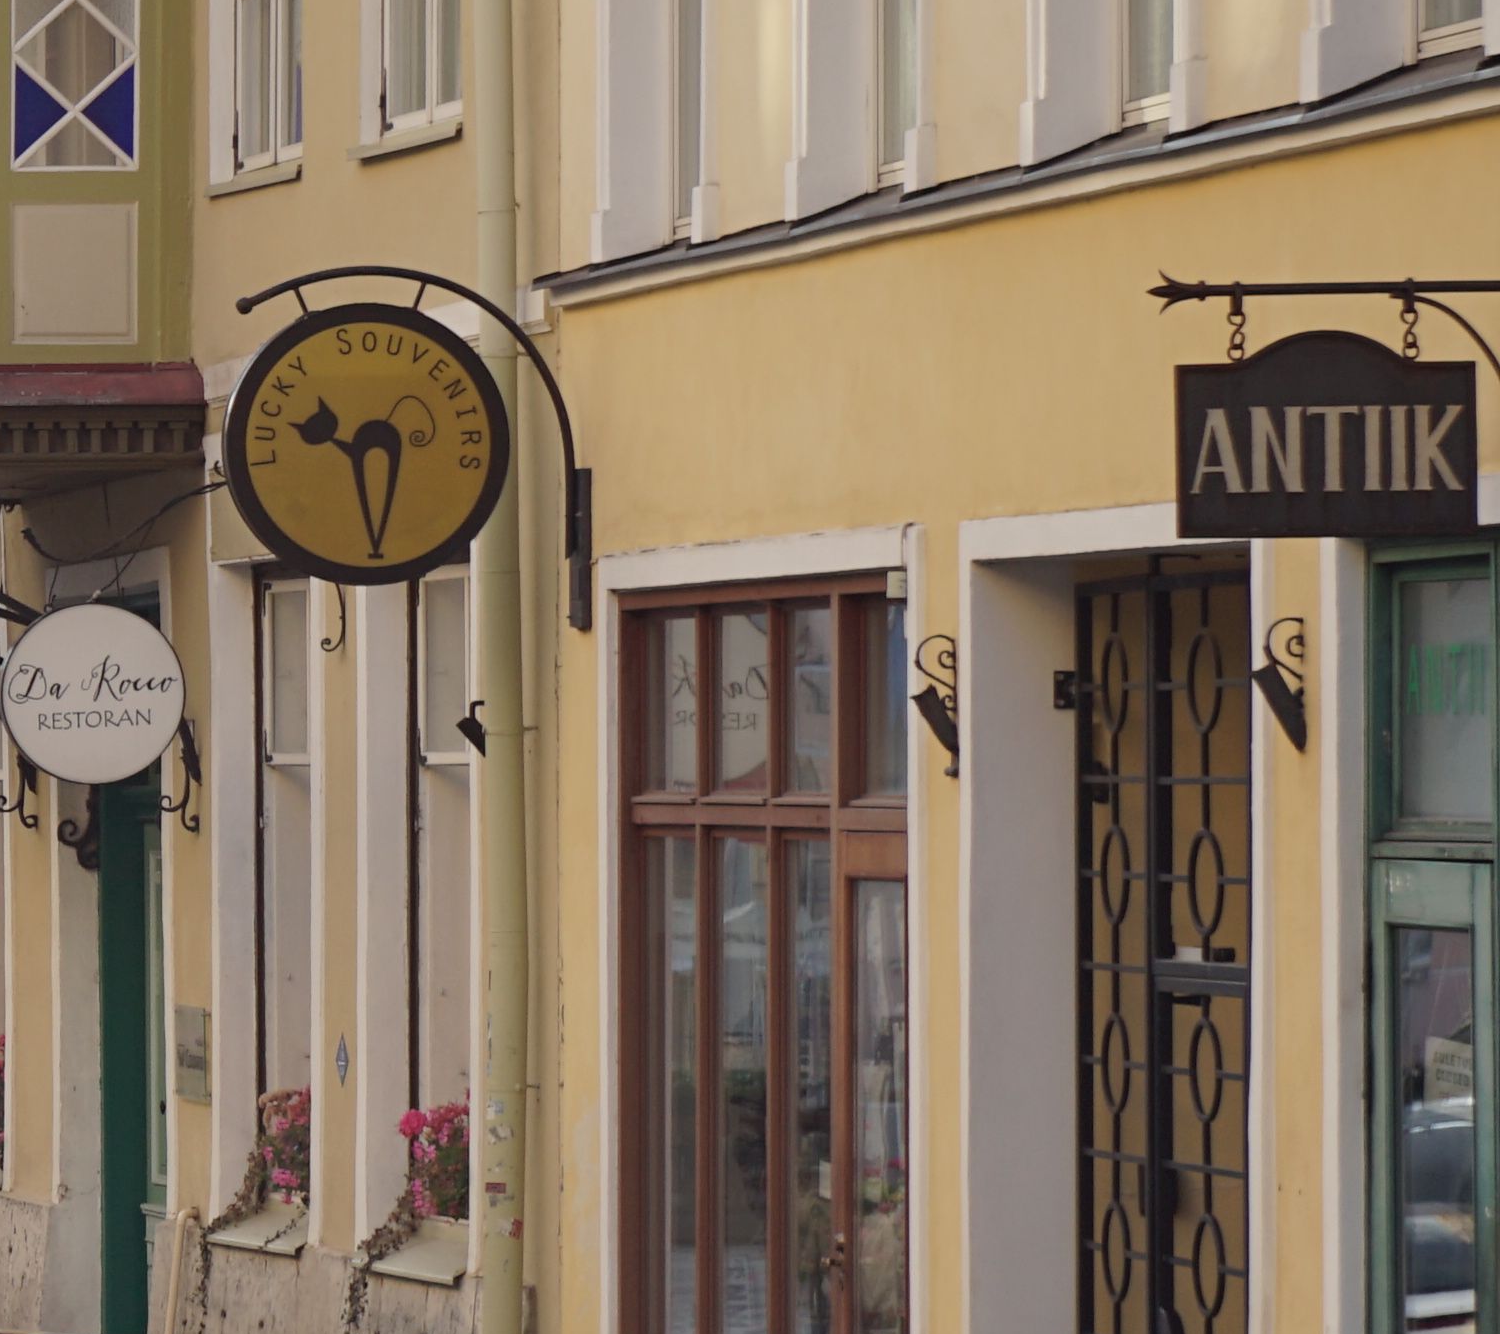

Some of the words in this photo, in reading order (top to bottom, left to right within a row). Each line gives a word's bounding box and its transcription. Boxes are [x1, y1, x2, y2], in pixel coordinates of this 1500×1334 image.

[249, 355, 310, 467] LUCKY
[335, 327, 482, 471] SOUVENIRS
[1189, 403, 1466, 495] ANTIIK
[8, 663, 71, 705] Da
[81, 654, 178, 703] Rocco
[37, 708, 153, 731] RESTORAN
